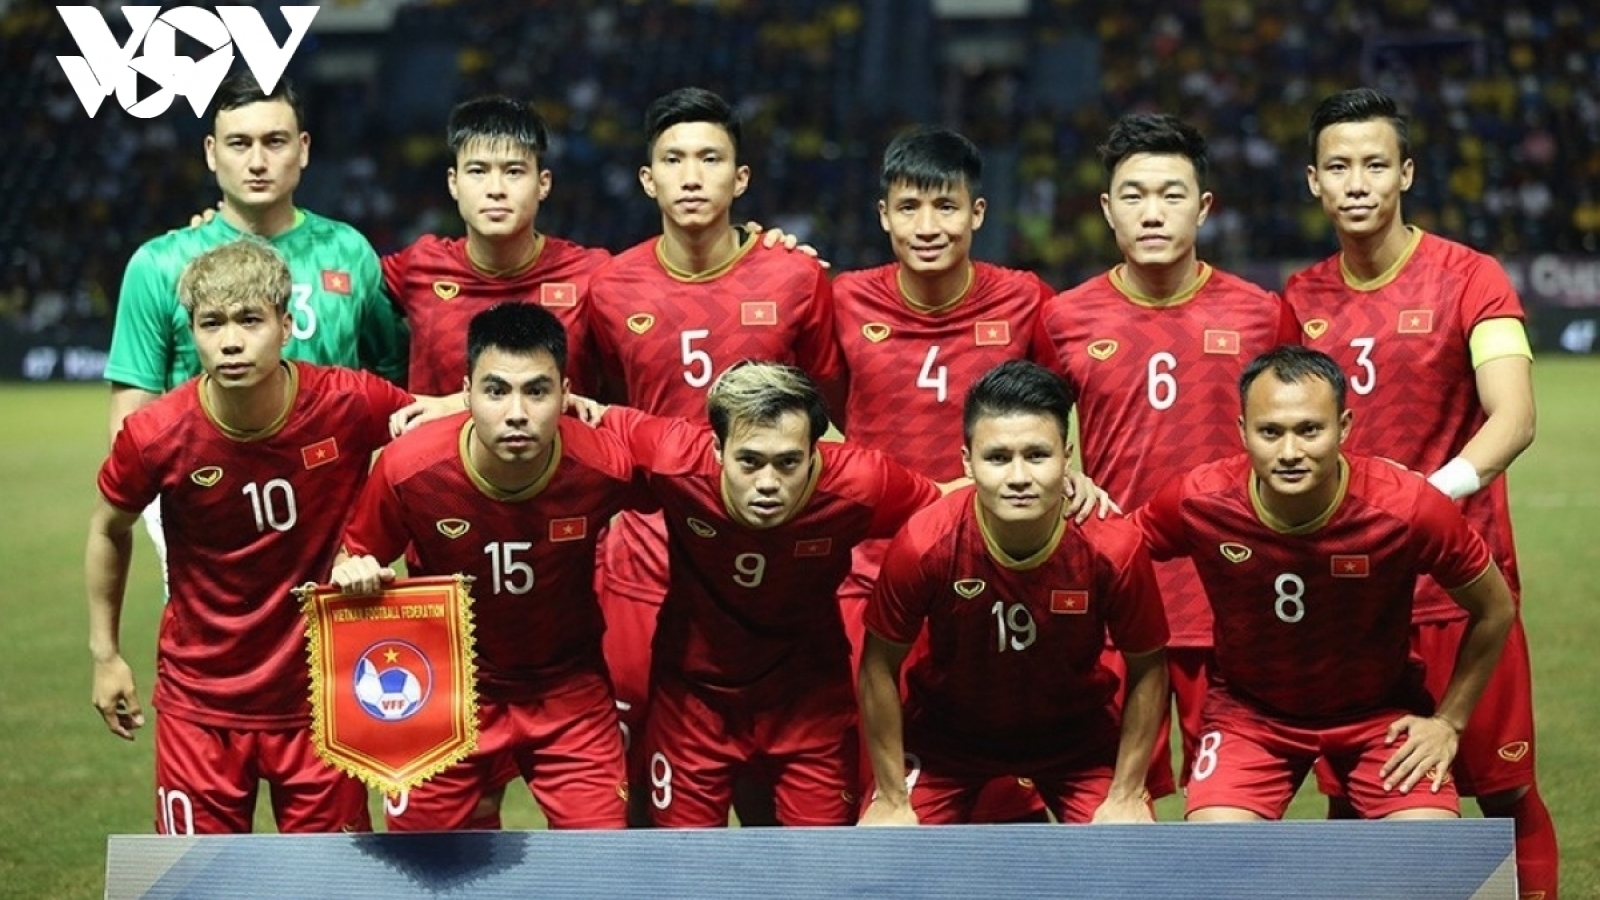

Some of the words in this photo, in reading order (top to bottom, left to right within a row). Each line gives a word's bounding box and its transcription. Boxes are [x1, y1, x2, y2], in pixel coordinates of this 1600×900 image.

[292, 283, 317, 340] 3
[680, 328, 713, 388] 5
[916, 345, 948, 403] 4
[1147, 350, 1178, 411] 6
[1349, 336, 1377, 395] 3
[242, 478, 298, 533] 10
[483, 541, 535, 595] 15
[732, 553, 766, 588] 9
[401, 603, 445, 619] FEDERATION
[1274, 573, 1305, 623] 8
[991, 601, 1037, 652] 19
[382, 699, 405, 711] VFF
[651, 751, 673, 810] 9
[1193, 730, 1222, 782] 8
[158, 786, 195, 836] 10
